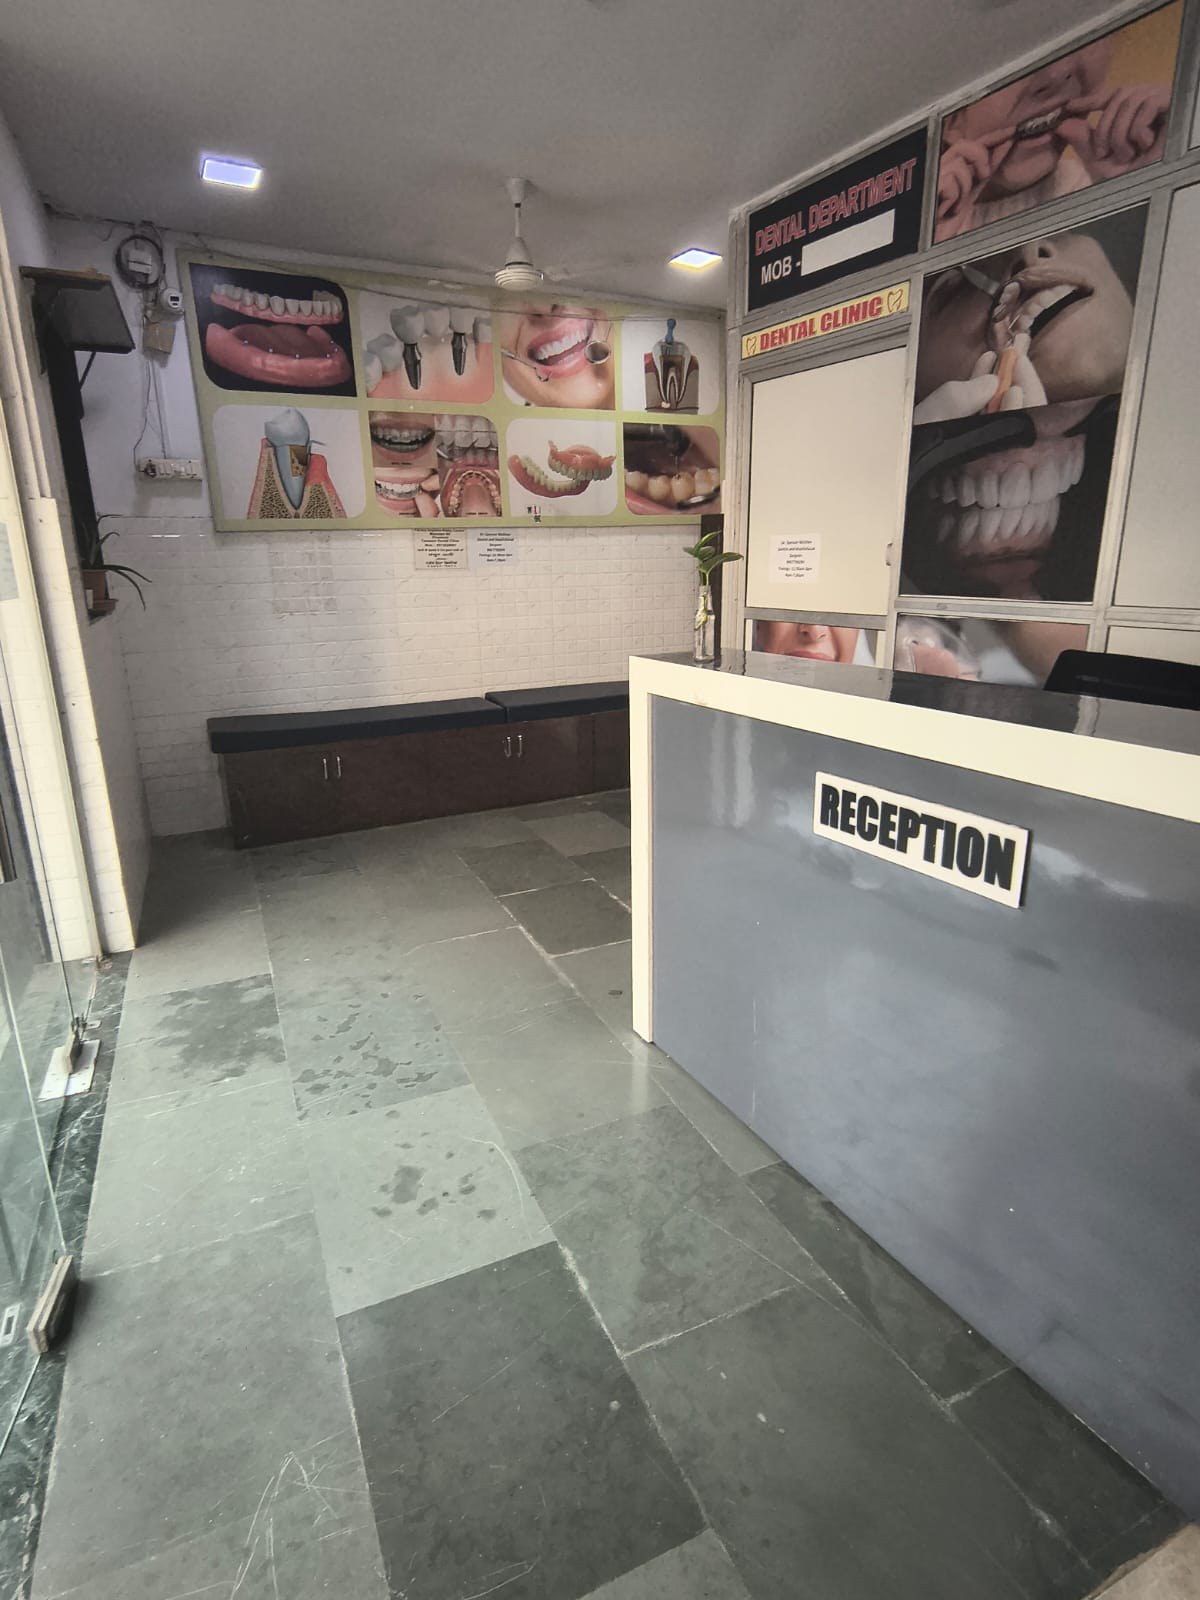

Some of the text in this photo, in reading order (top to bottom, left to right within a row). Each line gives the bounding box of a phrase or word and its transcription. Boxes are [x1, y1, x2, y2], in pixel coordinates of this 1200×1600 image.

[755, 158, 918, 256] DENTAL DEPARTMENT
[761, 255, 792, 285] MOB
[760, 296, 882, 351] DENTAL CLINIC
[820, 783, 1016, 891] RECEPTION
